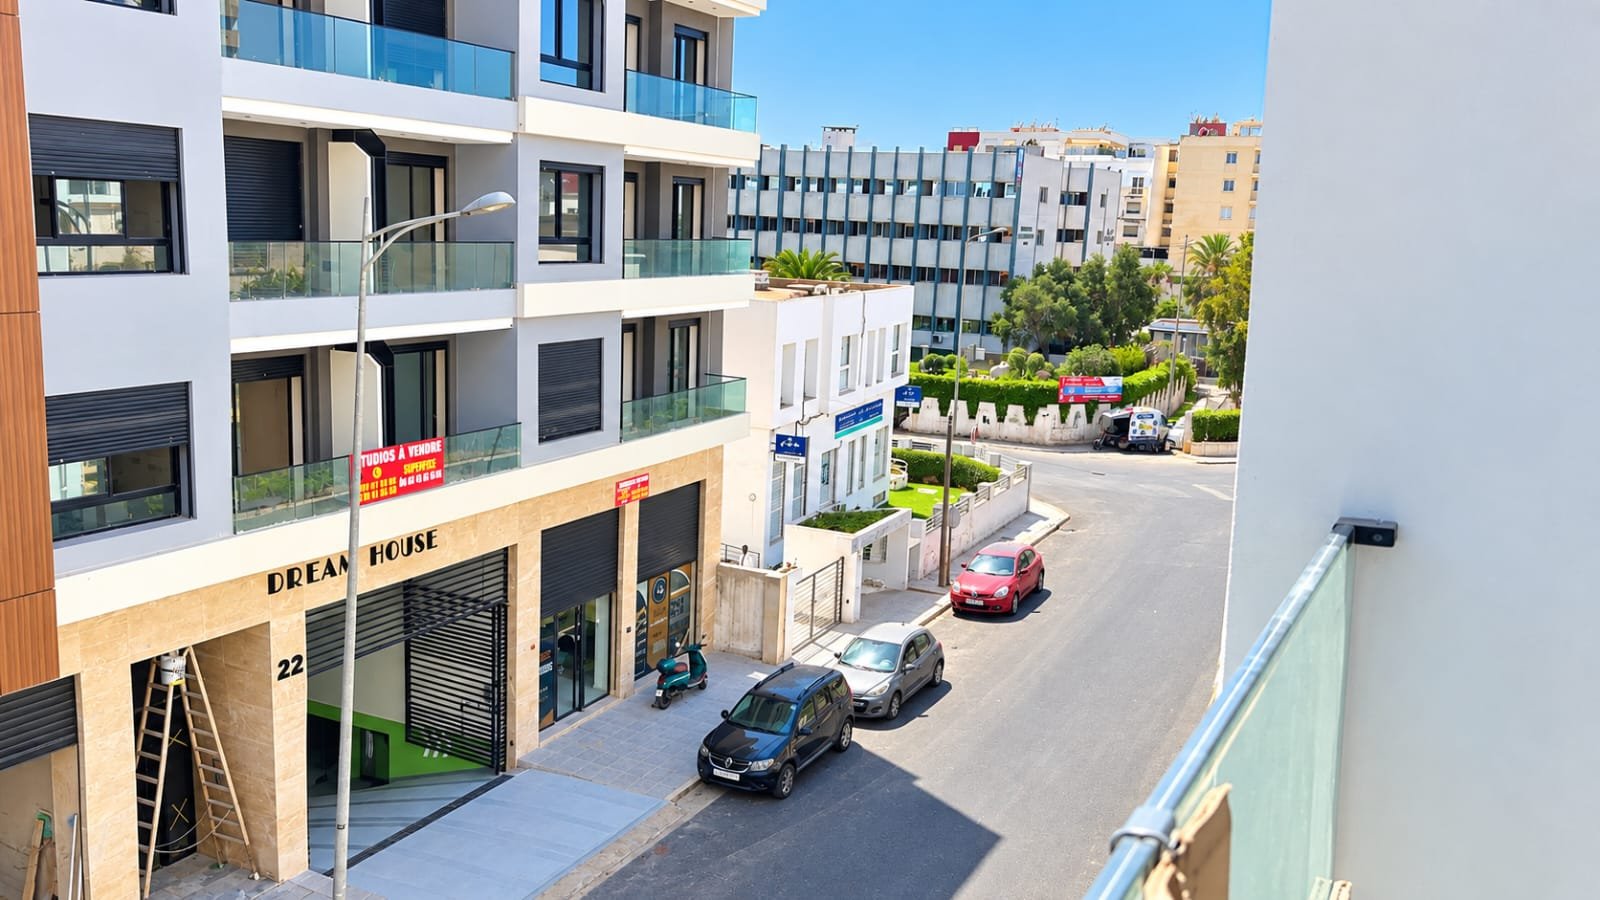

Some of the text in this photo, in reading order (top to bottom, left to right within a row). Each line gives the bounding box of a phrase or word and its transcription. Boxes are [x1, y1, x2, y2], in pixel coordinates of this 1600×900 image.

[361, 440, 442, 468] TUDIOS À VENDRE
[369, 529, 438, 566] HOUSE
[277, 654, 304, 682] 22
